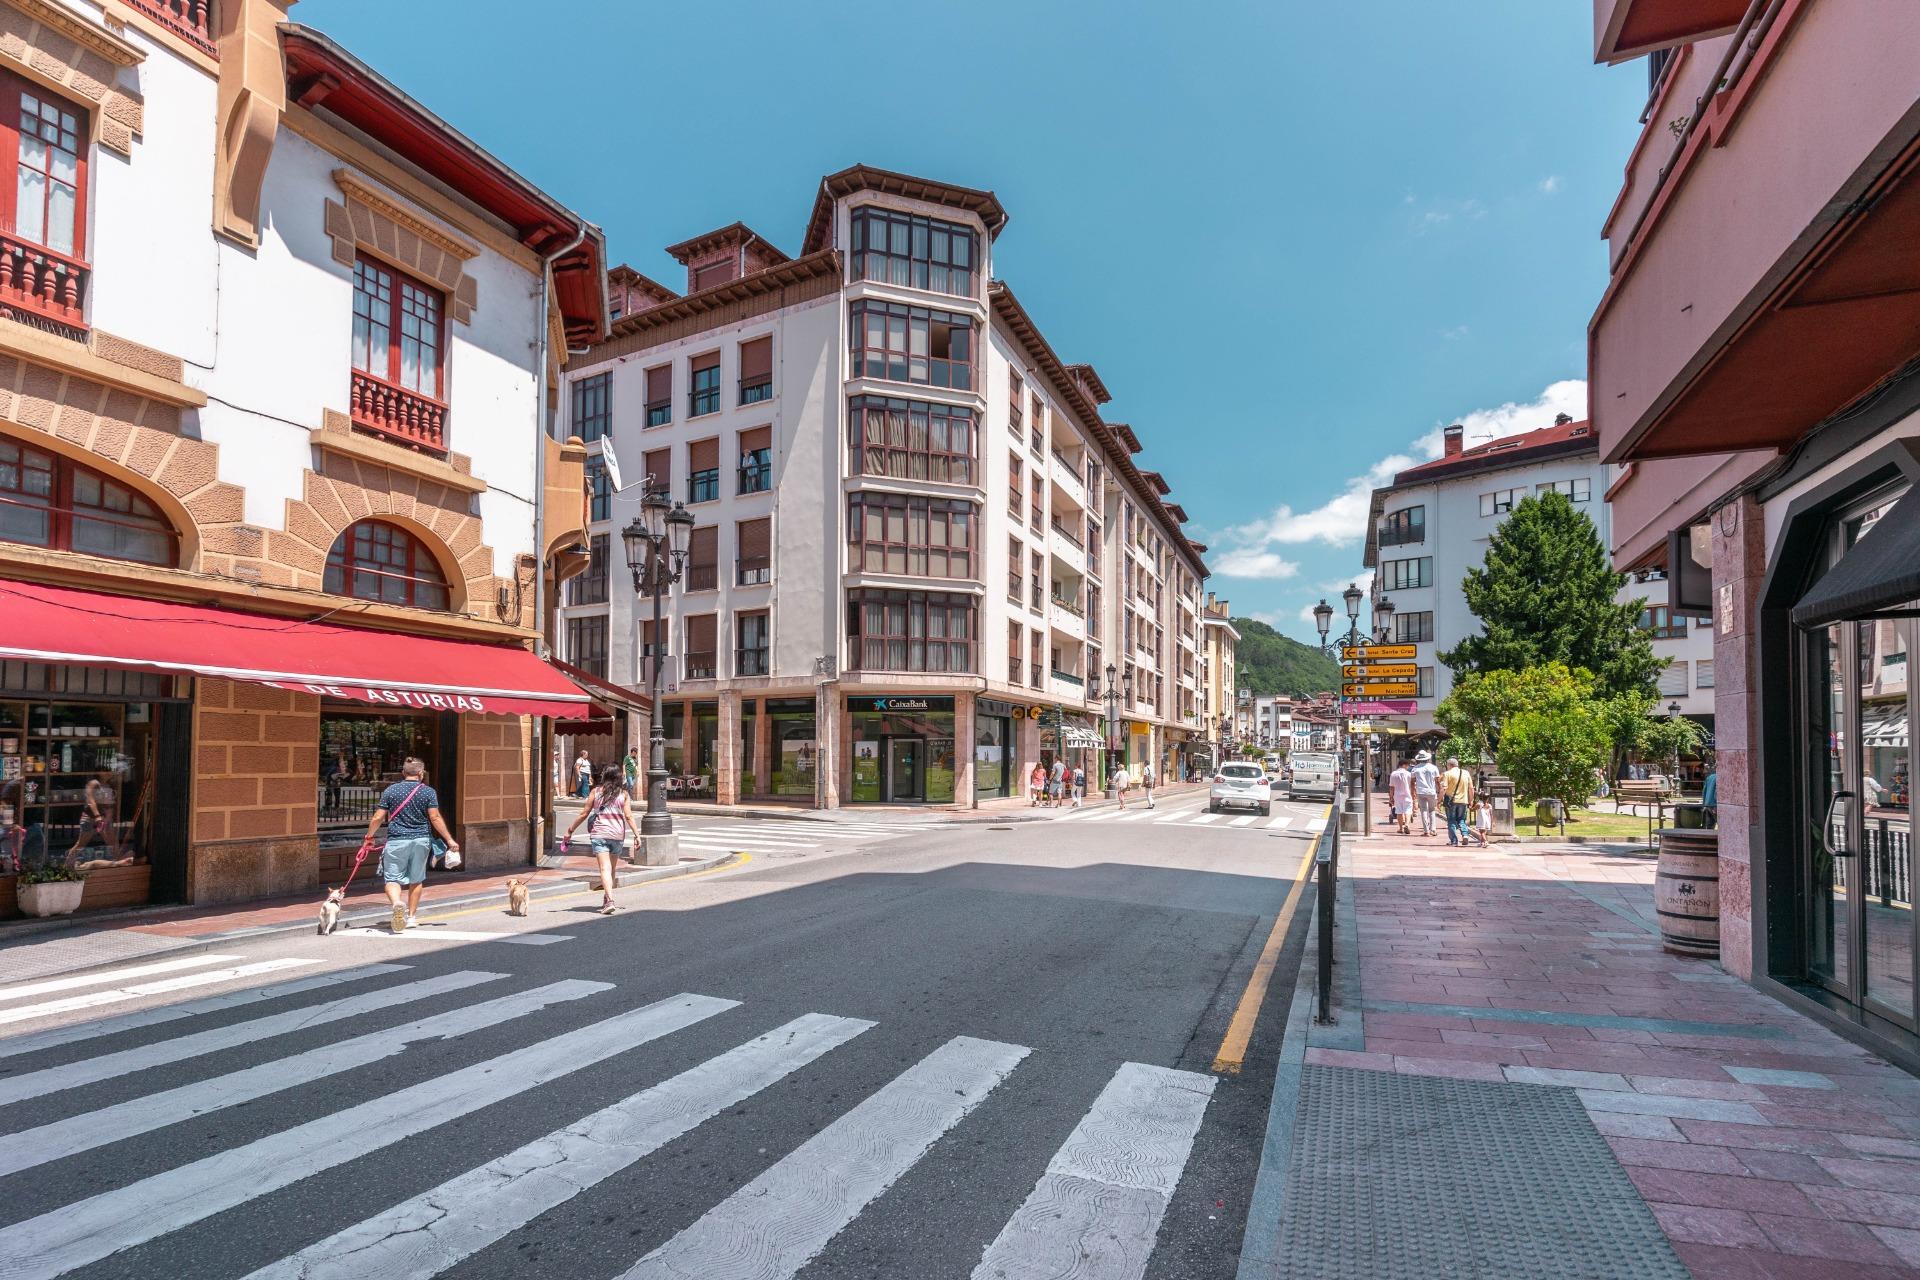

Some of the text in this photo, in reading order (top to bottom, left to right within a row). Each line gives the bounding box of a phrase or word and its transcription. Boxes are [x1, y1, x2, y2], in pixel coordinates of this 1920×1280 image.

[304, 684, 348, 697] DE
[366, 687, 484, 711] ASTURIAS
[888, 699, 928, 708] CaixaBank
